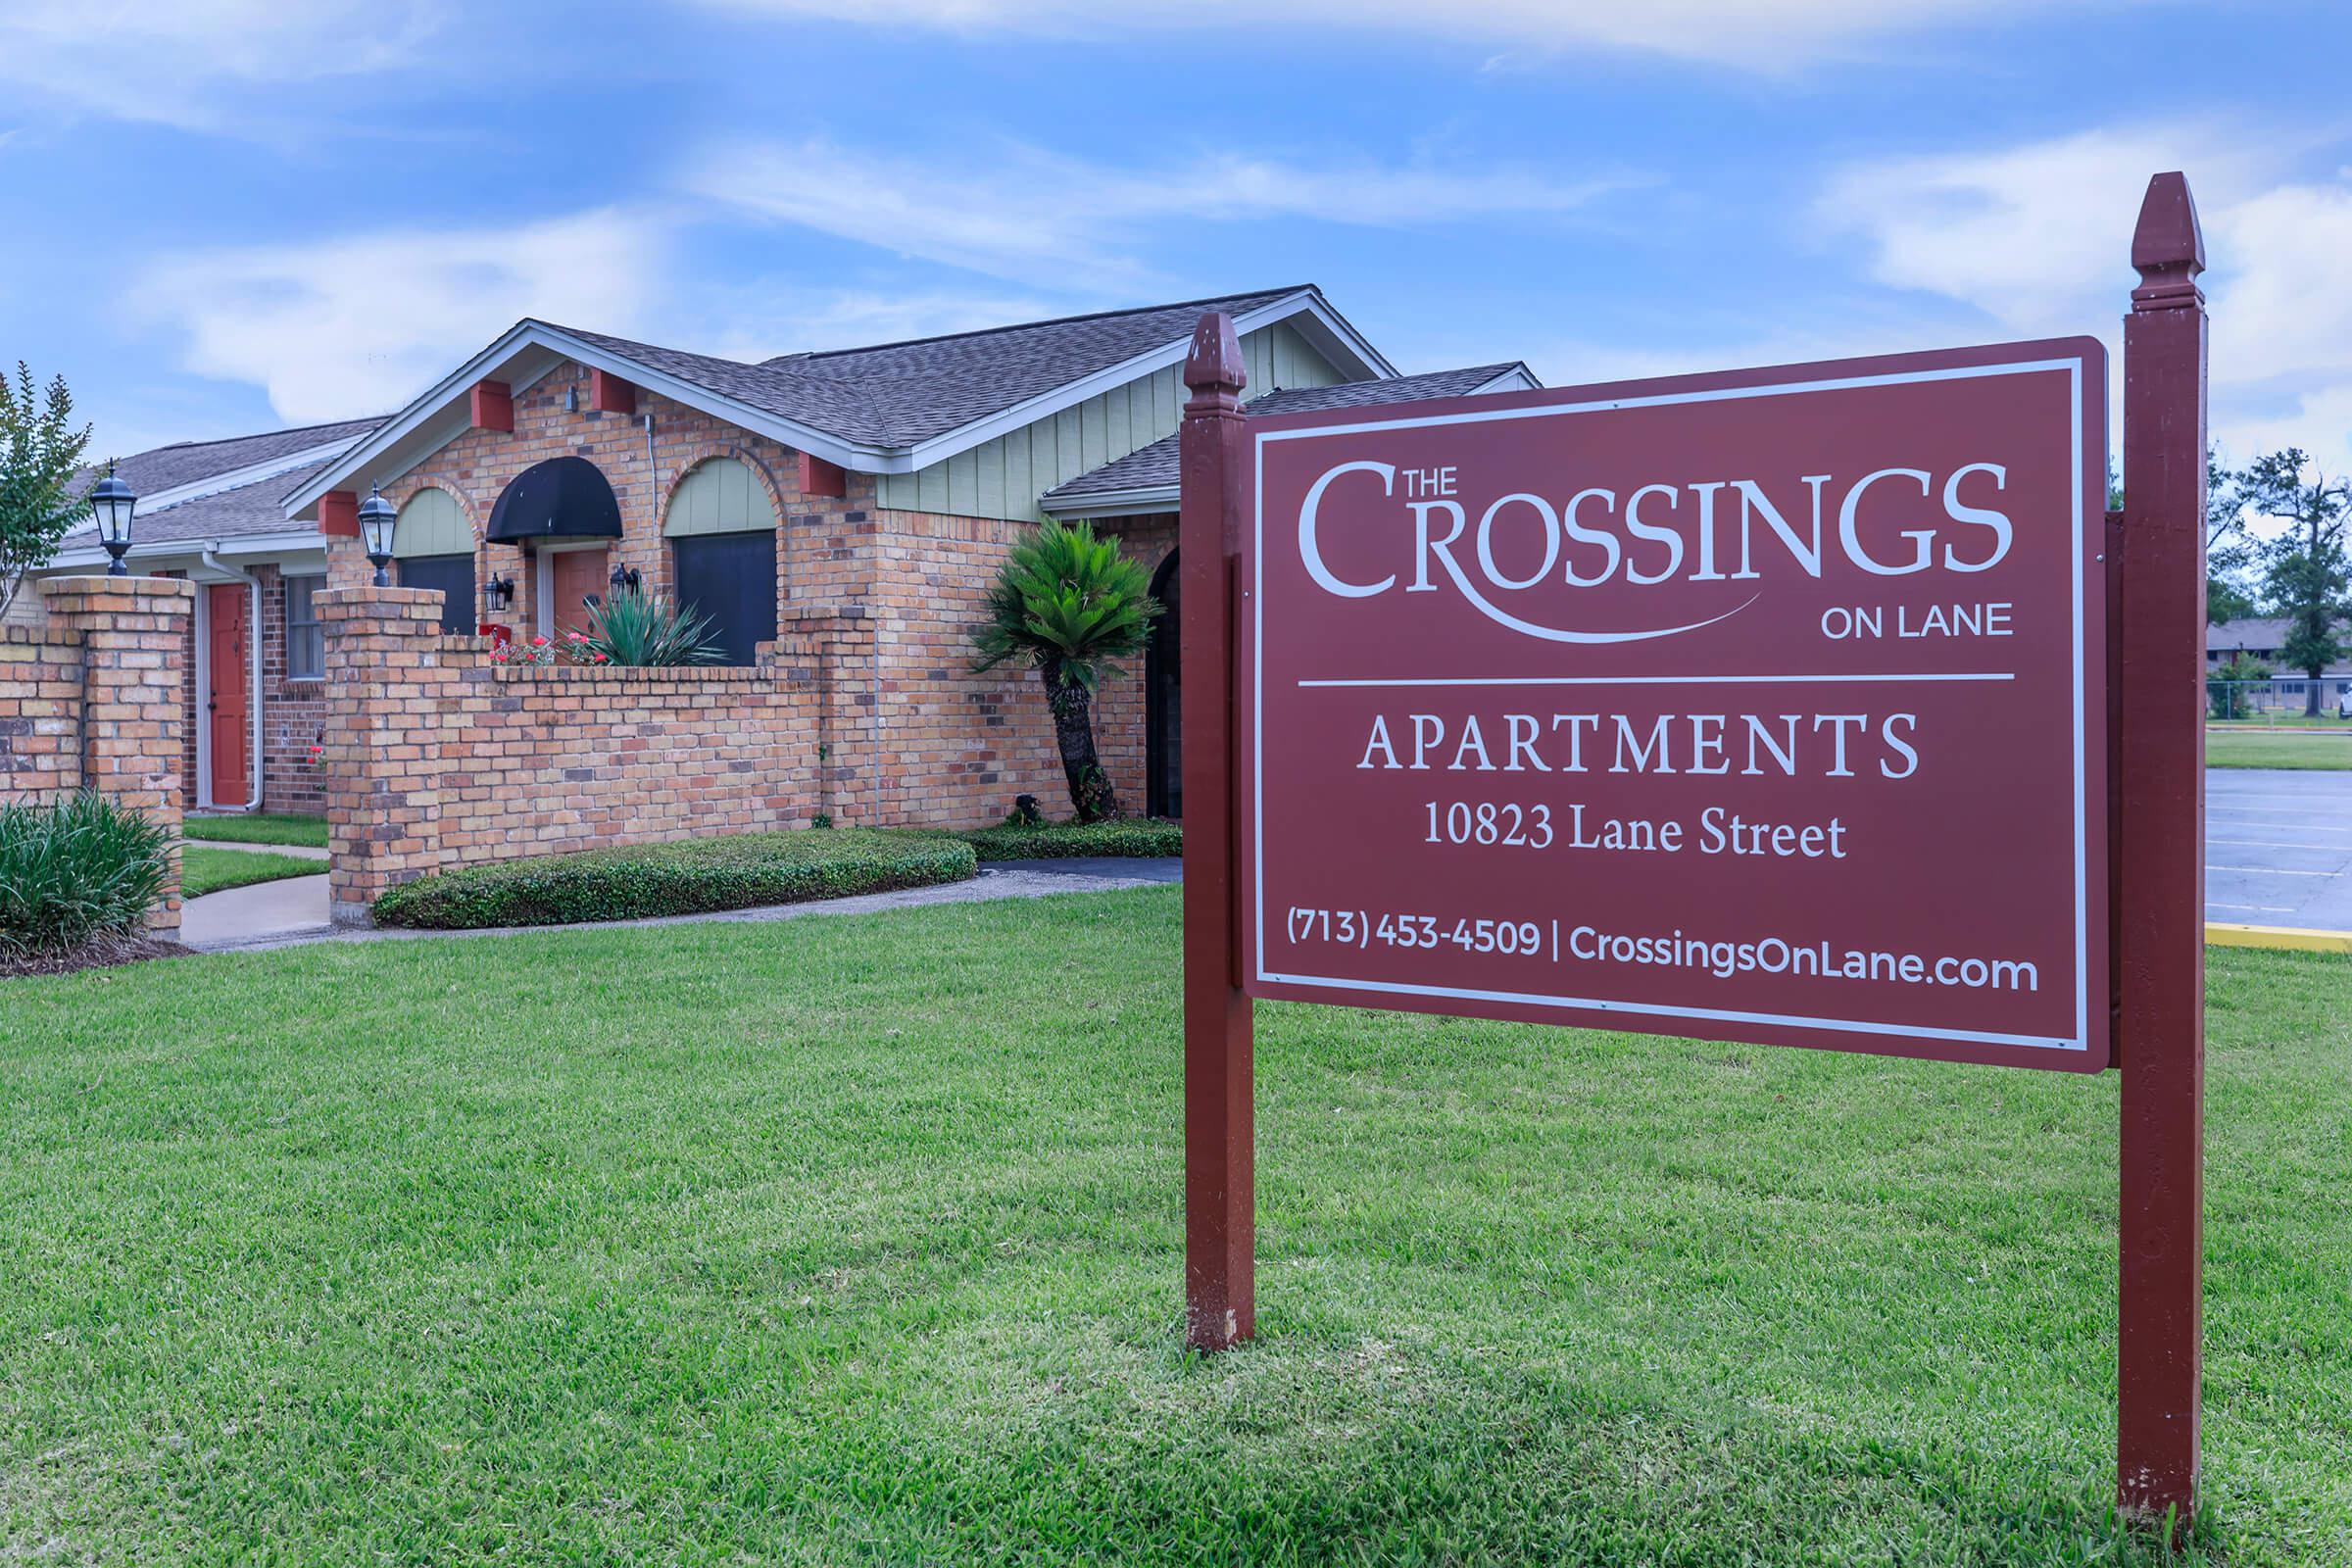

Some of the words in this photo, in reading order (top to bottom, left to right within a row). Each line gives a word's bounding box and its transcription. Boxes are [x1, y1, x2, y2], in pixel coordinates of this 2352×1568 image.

[1402, 466, 1457, 497] THE
[1298, 462, 2013, 643] CROSSINGS
[1822, 607, 1882, 639] ON
[1899, 604, 2013, 638] LANE
[1356, 713, 1918, 778] APARTMENTS
[1426, 802, 1553, 849] 10823
[1569, 804, 1683, 852] Lane
[1700, 807, 1847, 858] Street
[1287, 906, 1369, 949] (713)
[1377, 913, 1541, 956] 453-4509
[1570, 926, 2037, 991] CrossingsOnLane.com
